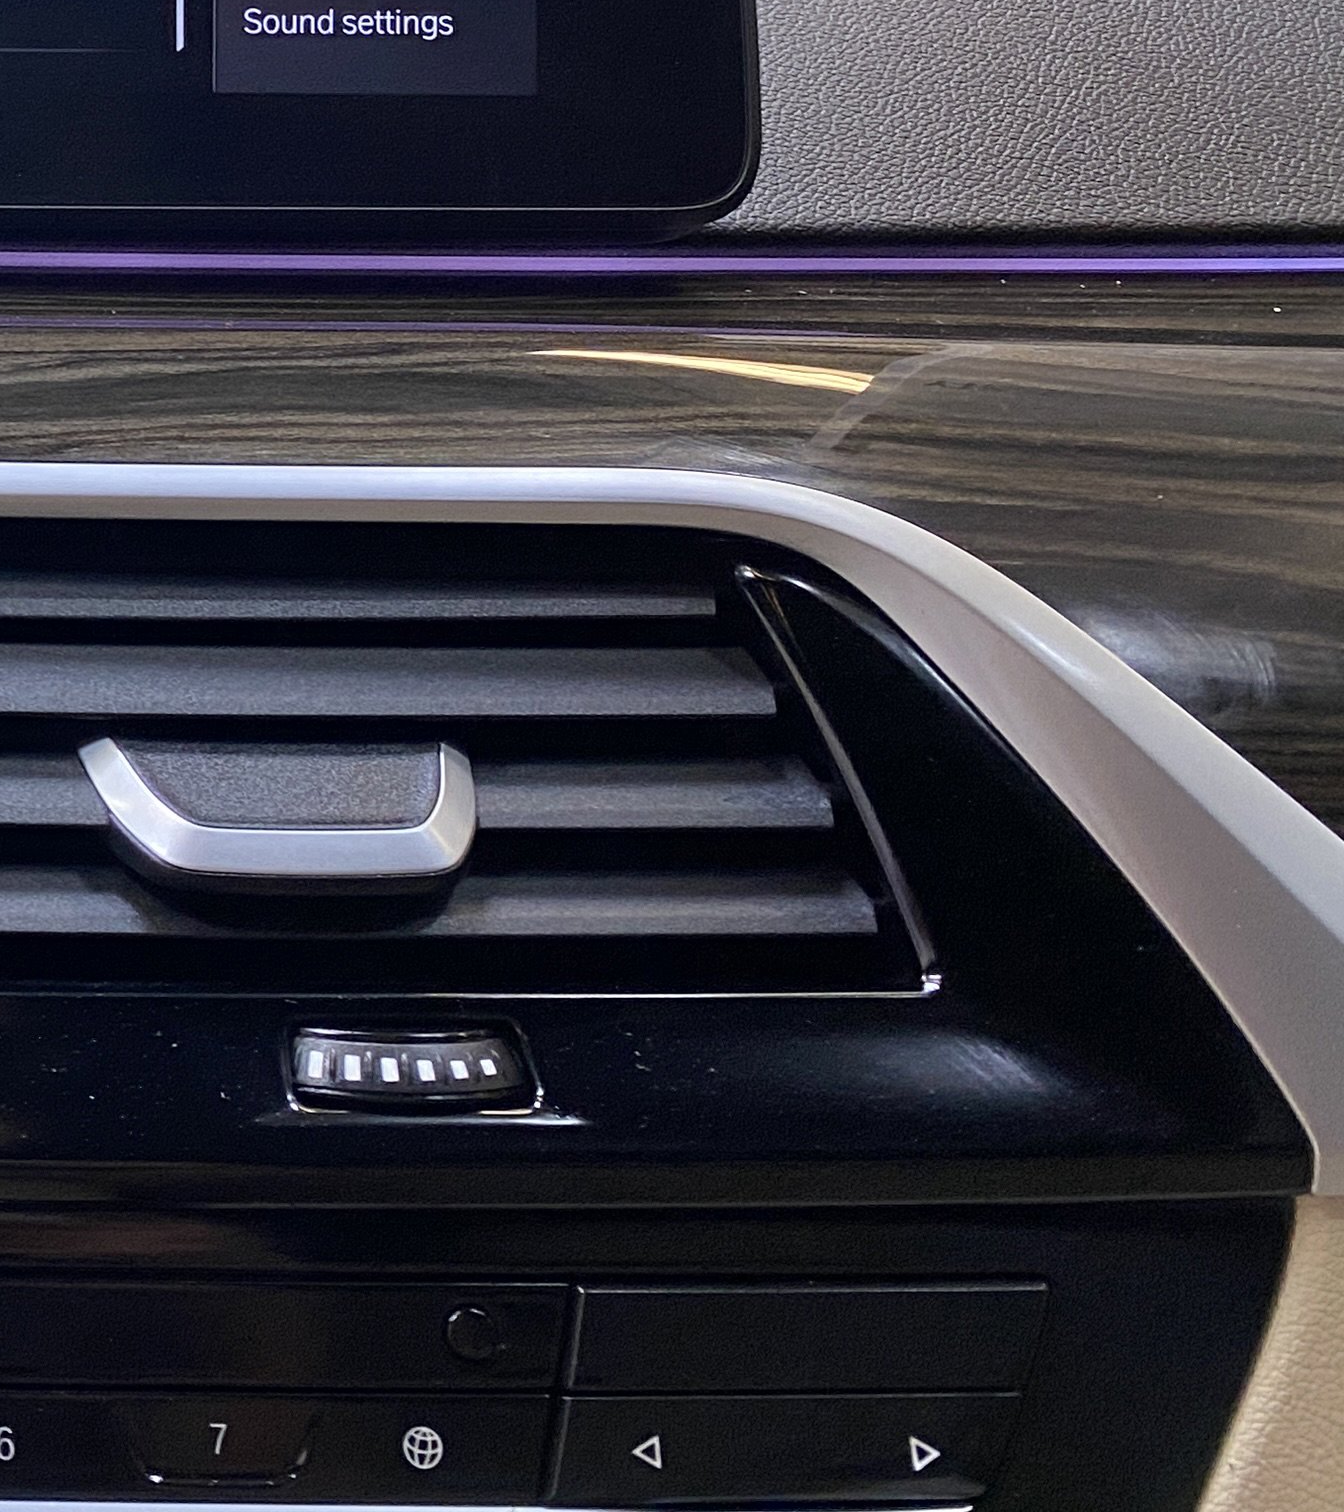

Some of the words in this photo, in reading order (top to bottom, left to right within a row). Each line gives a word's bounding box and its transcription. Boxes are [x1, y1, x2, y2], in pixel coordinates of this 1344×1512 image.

[243, 7, 334, 35] Sound
[342, 8, 454, 41] settings
[209, 1423, 228, 1455] 7
